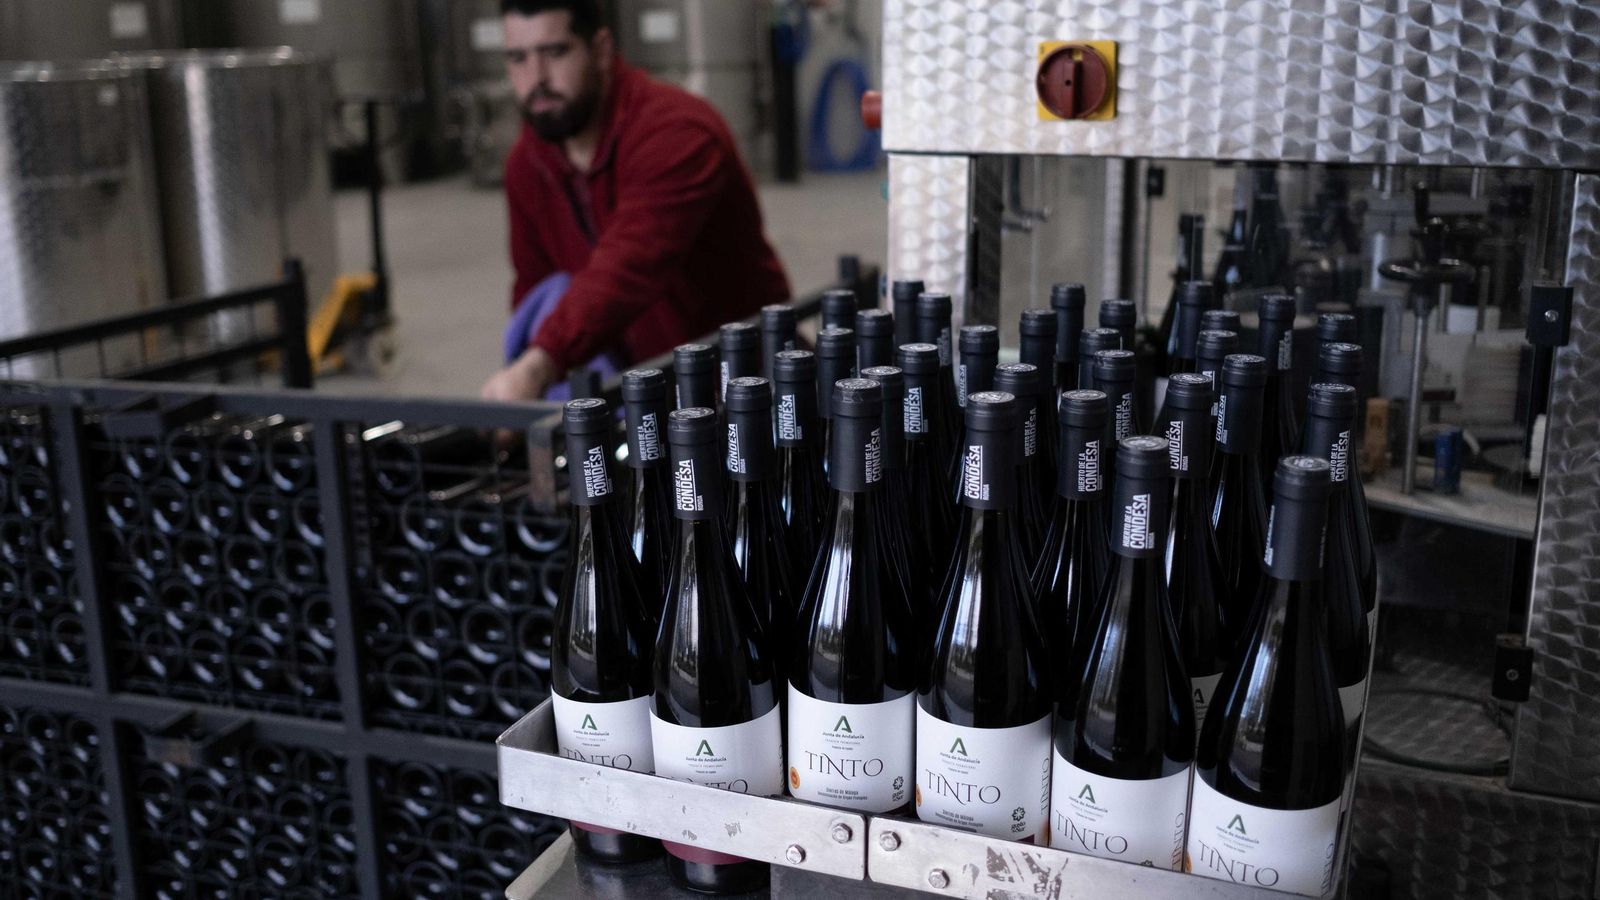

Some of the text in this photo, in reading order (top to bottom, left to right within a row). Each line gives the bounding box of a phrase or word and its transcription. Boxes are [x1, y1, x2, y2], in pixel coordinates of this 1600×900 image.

[782, 394, 794, 440] CONDESA
[908, 387, 921, 433] CONDESA
[1029, 407, 1037, 455] CONDESA
[1122, 392, 1132, 438] CONDESA
[638, 432, 646, 440] DE
[638, 440, 647, 460] HUERTO
[642, 413, 659, 460] CONDESA
[728, 423, 739, 472] CONDESA
[865, 443, 872, 451] LA
[866, 452, 872, 460] DE
[871, 427, 881, 482] CONDESA
[1331, 452, 1337, 460] DE
[1336, 430, 1348, 481] CONDESA
[584, 460, 594, 498] HUERTO DE LA
[588, 446, 607, 496] CONDESA
[675, 480, 681, 488] DE
[678, 460, 694, 511] CONDESA
[968, 445, 980, 499] CONDESA
[1078, 461, 1086, 469] DE
[1078, 470, 1086, 492] HUERTO
[1085, 440, 1098, 492] CONDESA
[1122, 506, 1132, 548] HUERTO DE LA
[1130, 494, 1147, 549] CONDESA
[805, 750, 884, 780] TINTO
[925, 768, 1001, 806] TINTO
[1056, 809, 1128, 854] TINTO
[1198, 840, 1280, 887] TINTO
